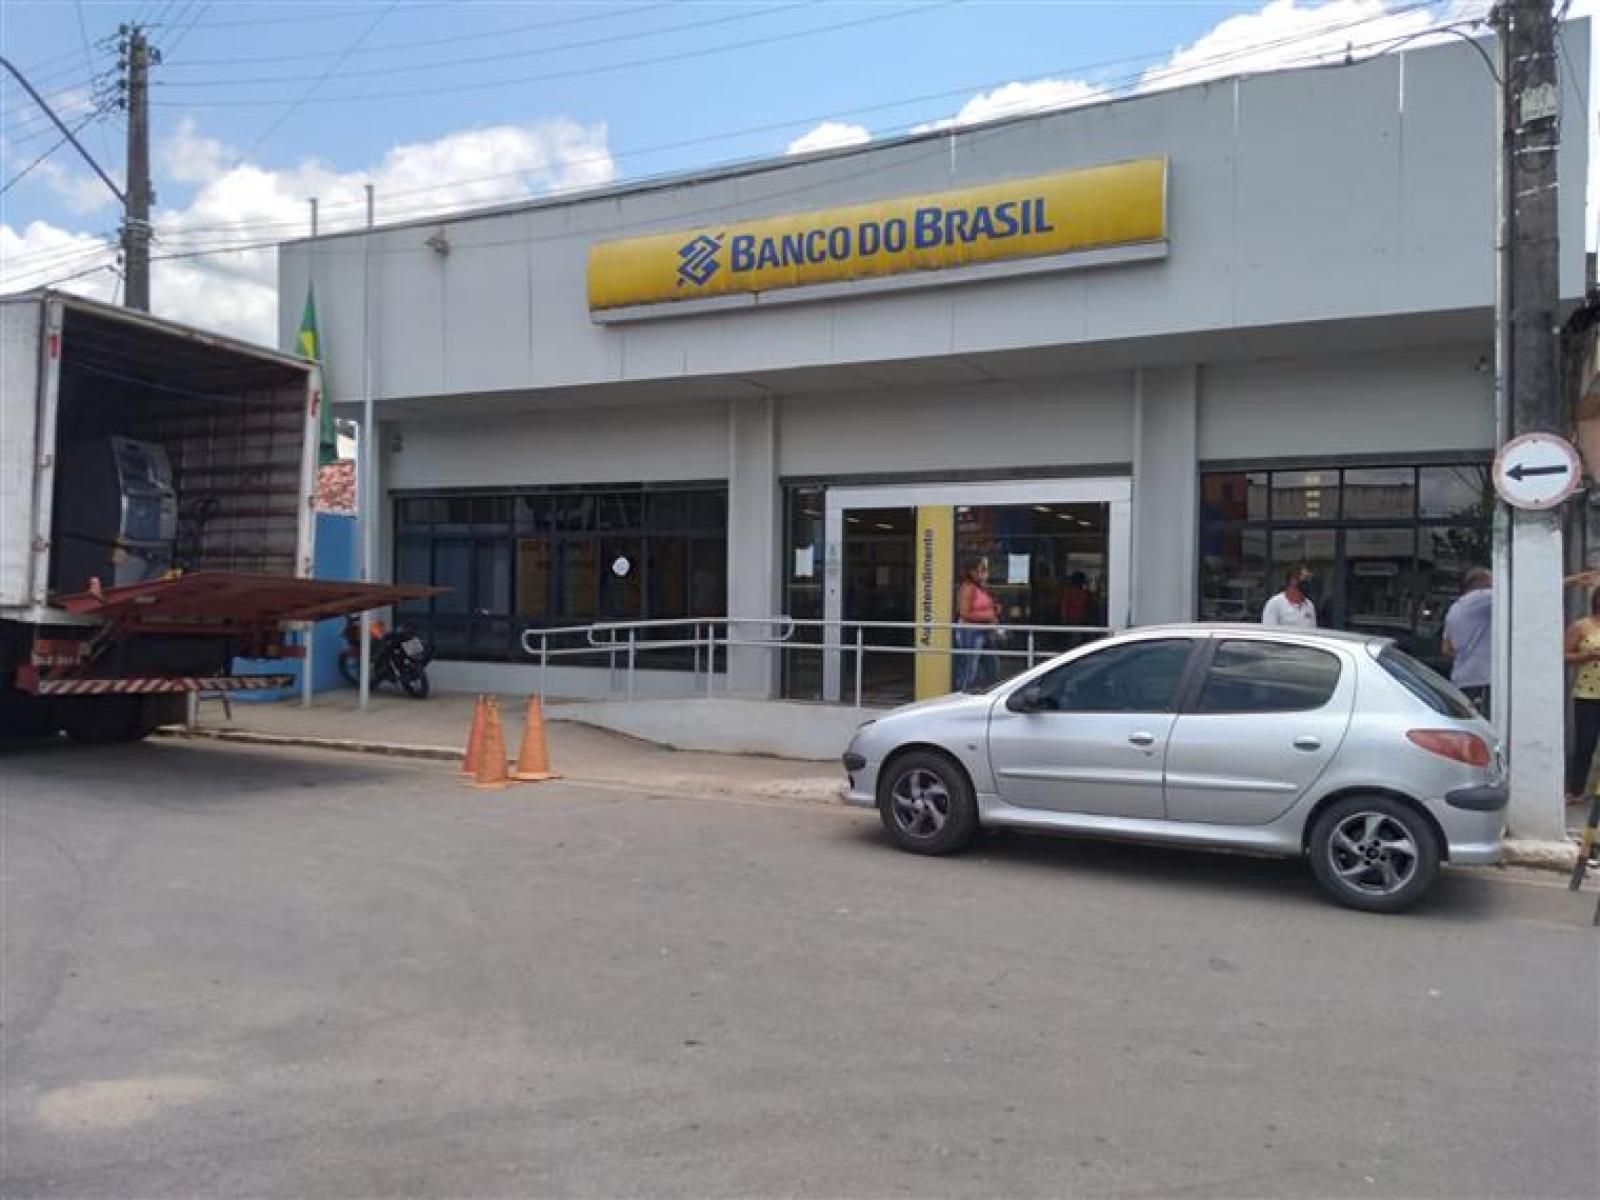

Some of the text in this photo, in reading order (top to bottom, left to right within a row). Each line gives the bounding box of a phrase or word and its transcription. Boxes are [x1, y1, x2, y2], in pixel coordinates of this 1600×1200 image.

[731, 198, 1054, 272] BANCO DO BRASIL
[920, 528, 933, 647] Auoatendimento
